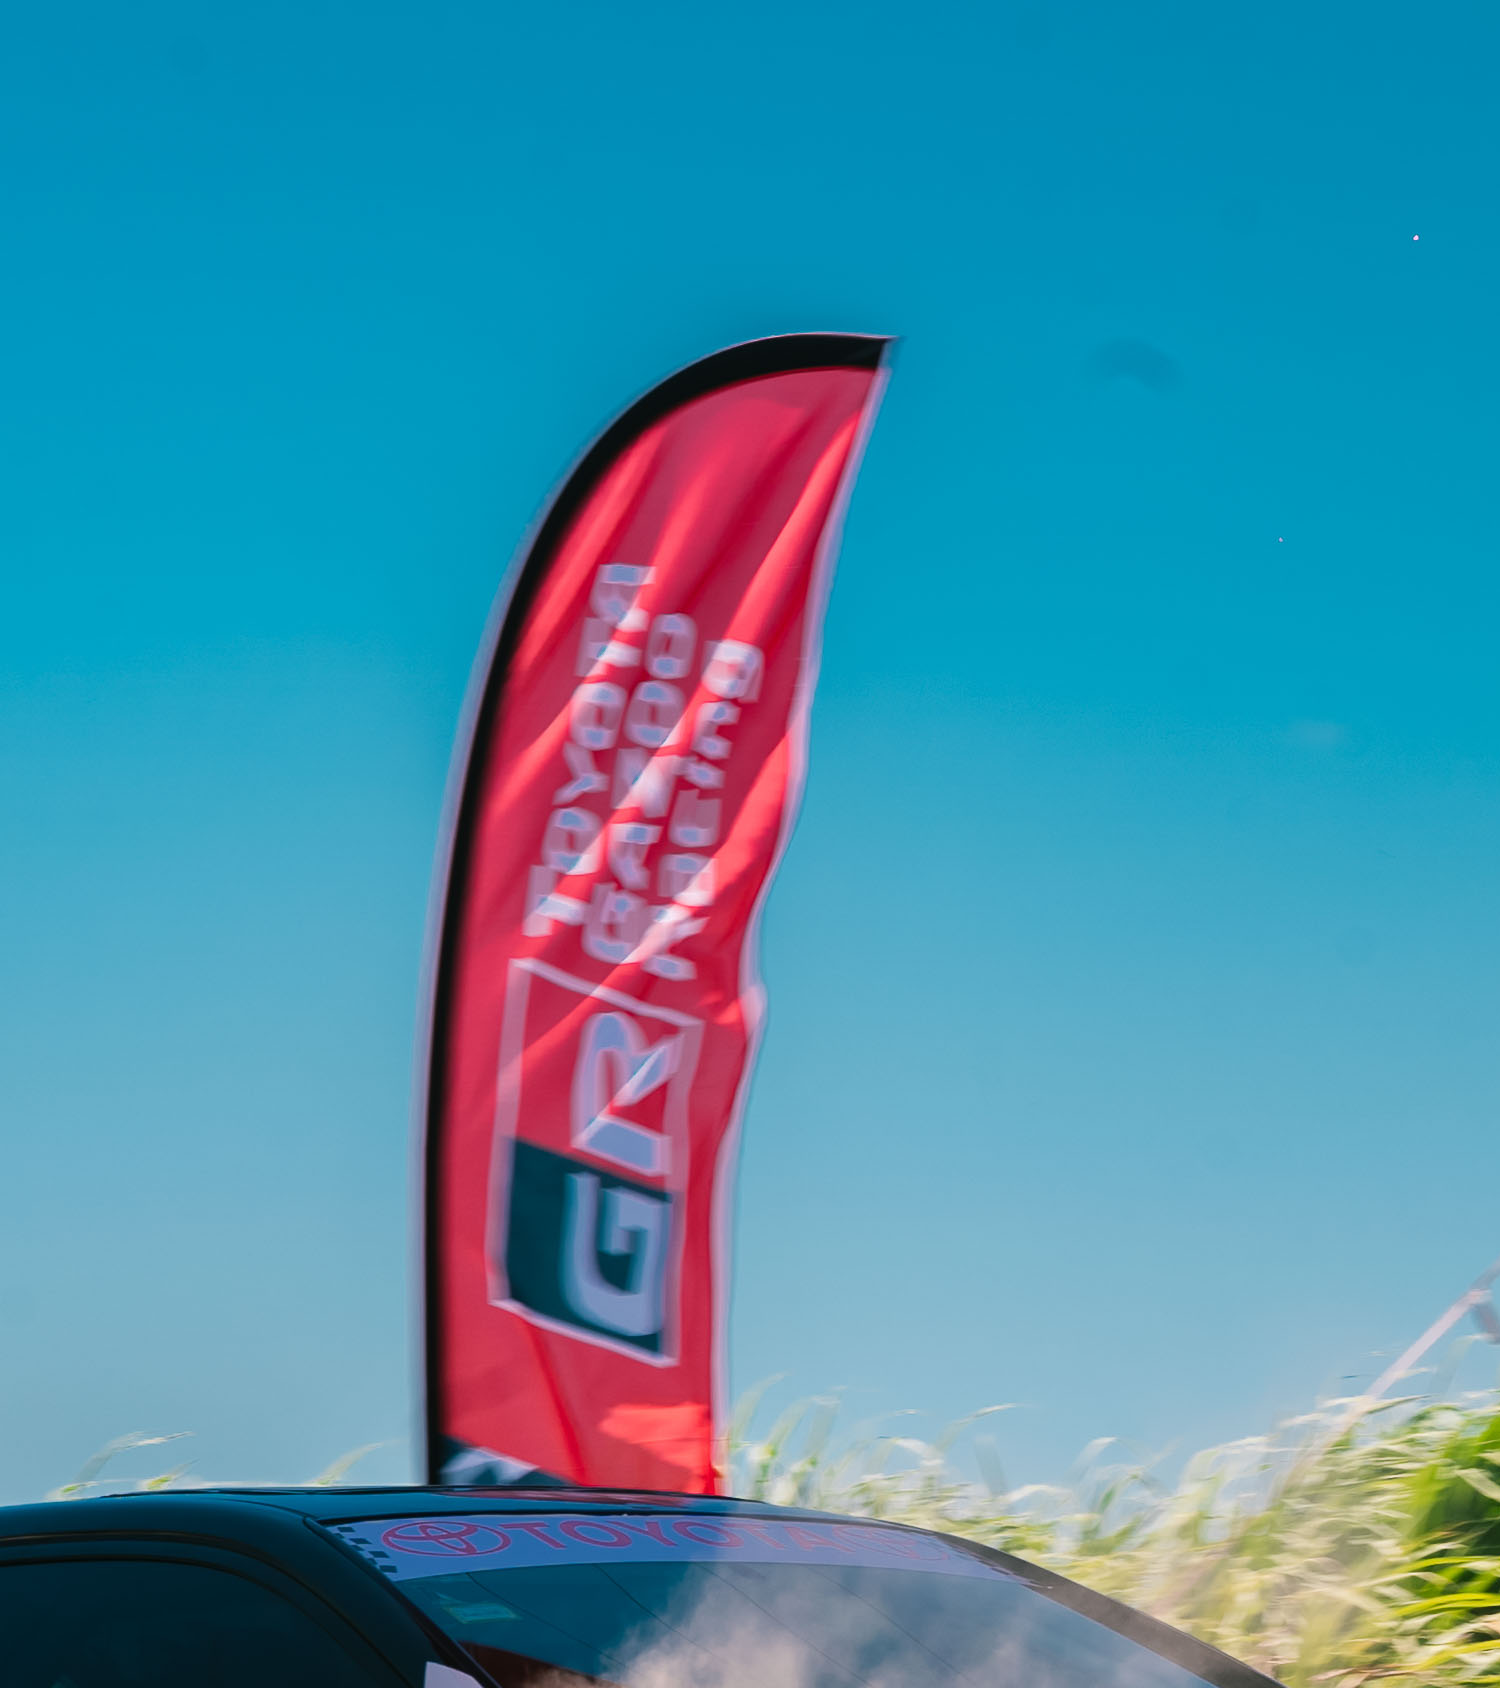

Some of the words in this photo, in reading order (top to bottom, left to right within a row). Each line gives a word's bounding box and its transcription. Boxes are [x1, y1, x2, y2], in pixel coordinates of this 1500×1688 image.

[522, 563, 657, 937] TOYOTA
[581, 613, 697, 964] GAZOO
[560, 1011, 674, 1337] GR
[499, 1519, 857, 1554] TOYOTA
